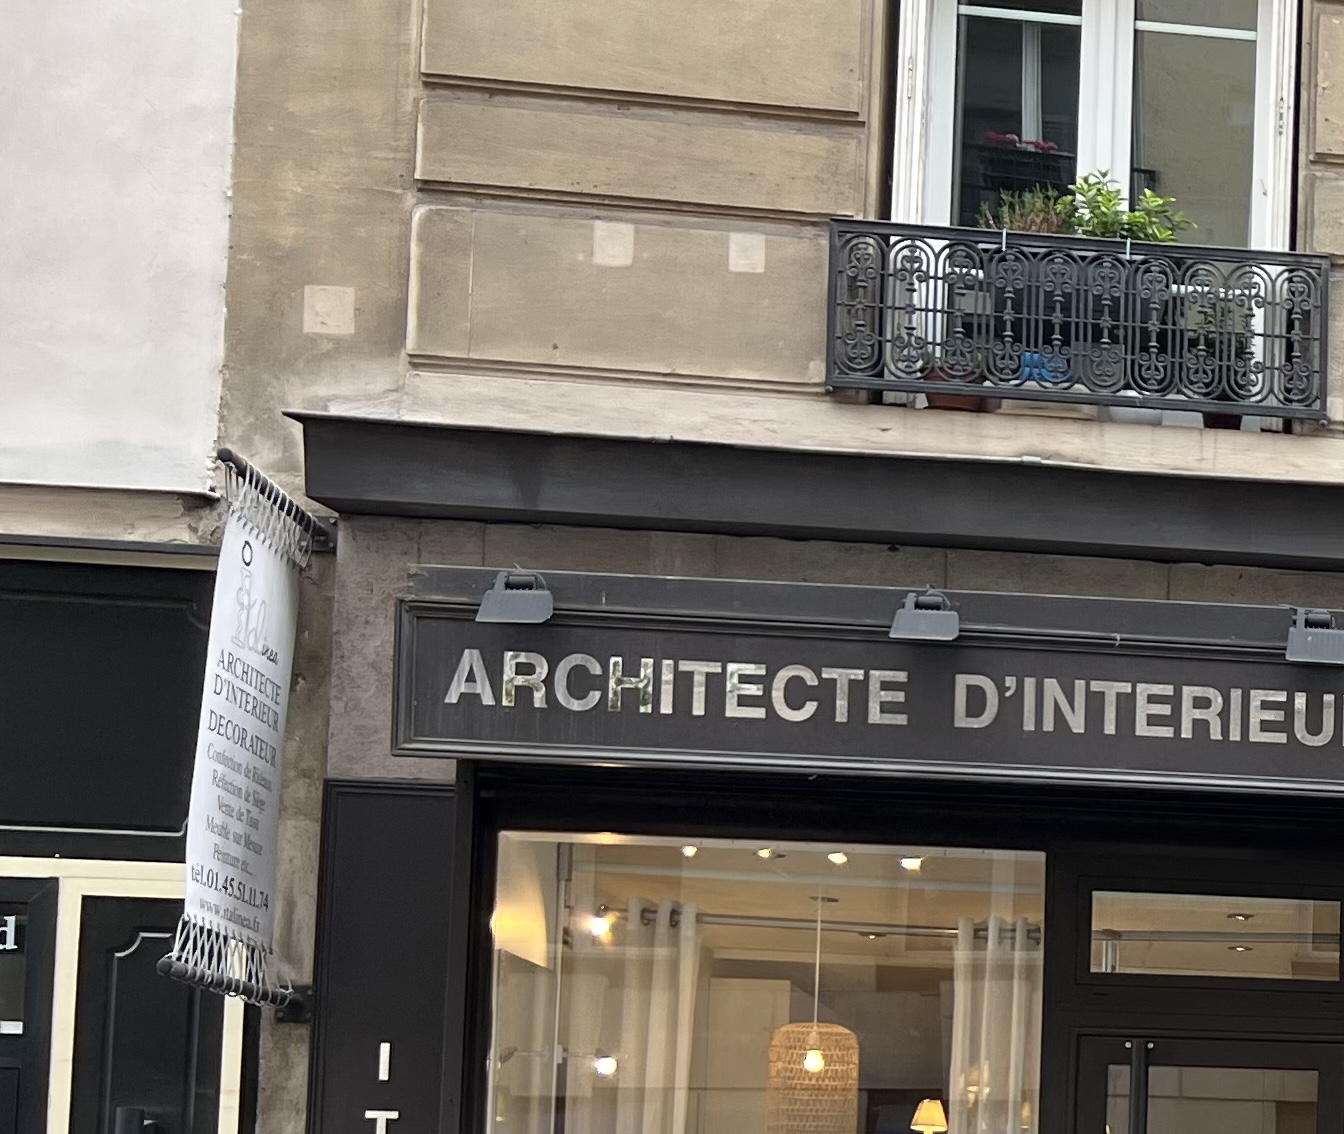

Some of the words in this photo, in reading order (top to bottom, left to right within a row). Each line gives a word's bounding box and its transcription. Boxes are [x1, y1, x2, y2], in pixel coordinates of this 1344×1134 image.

[214, 674, 279, 732] D'INTERIEUR
[217, 649, 281, 705] ARCHITECTE
[443, 648, 909, 726] ARCHITECTE
[207, 743, 243, 776] Confection
[208, 709, 278, 769] DECORATEUR
